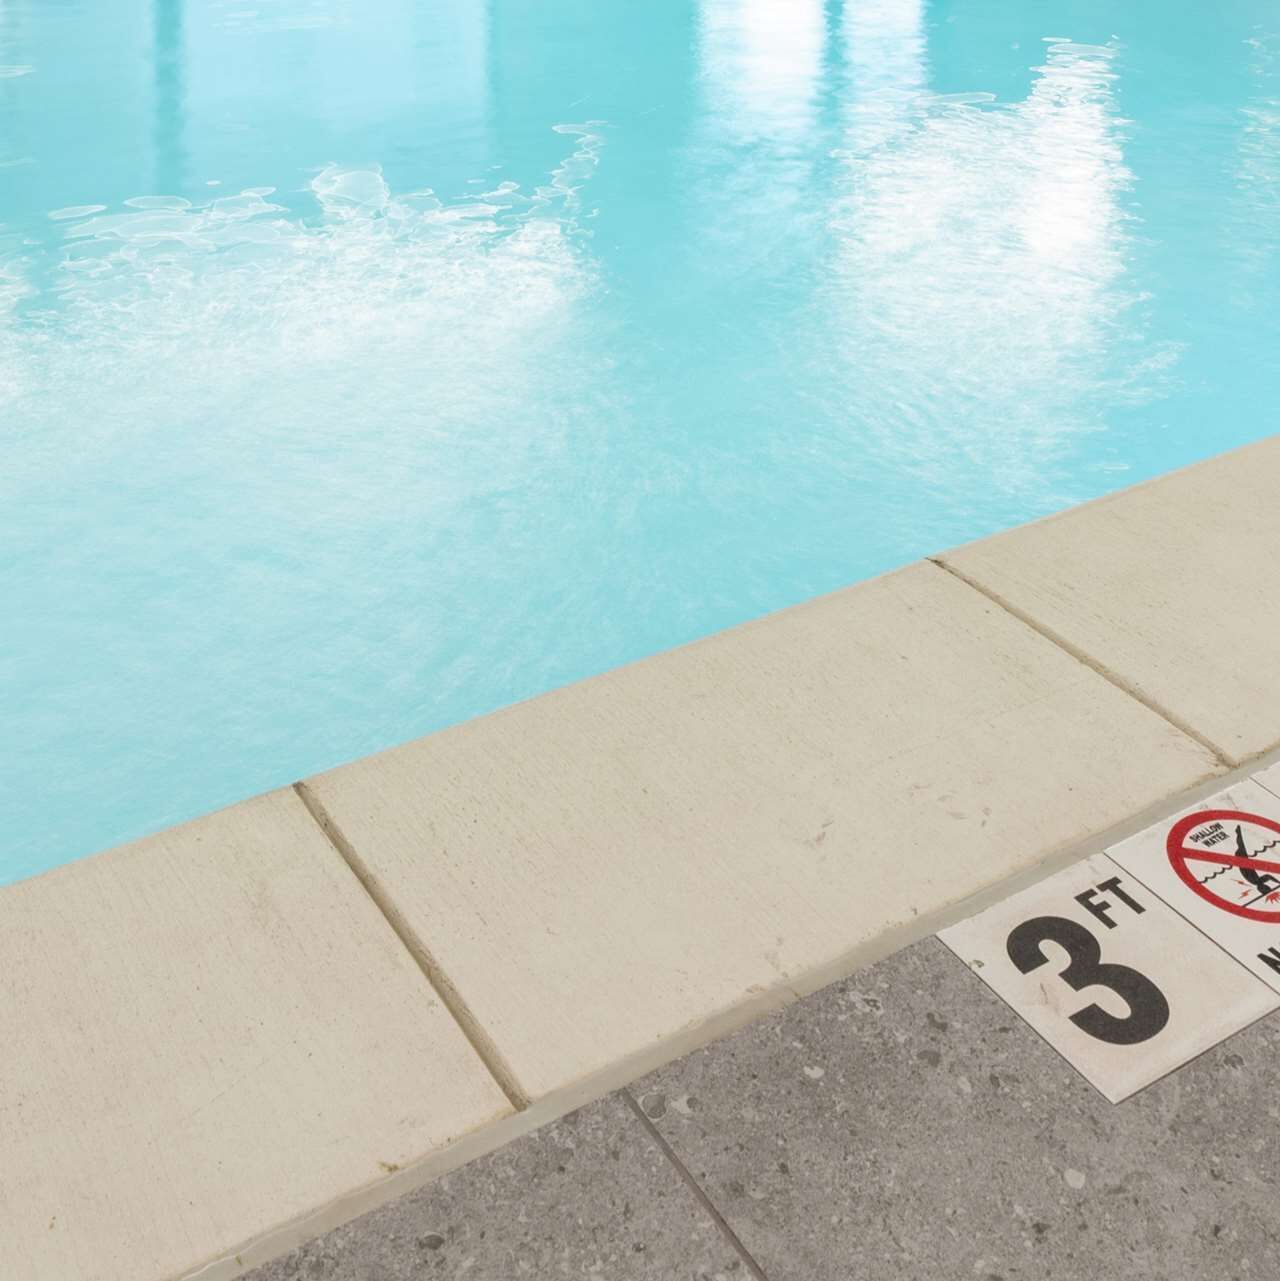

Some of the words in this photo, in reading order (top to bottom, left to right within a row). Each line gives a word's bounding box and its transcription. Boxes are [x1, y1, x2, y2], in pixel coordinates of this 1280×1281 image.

[1189, 822, 1224, 843] SHALLOW
[1202, 831, 1231, 848] WATER
[1074, 876, 1147, 931] FT
[1005, 914, 1171, 1046] 3
